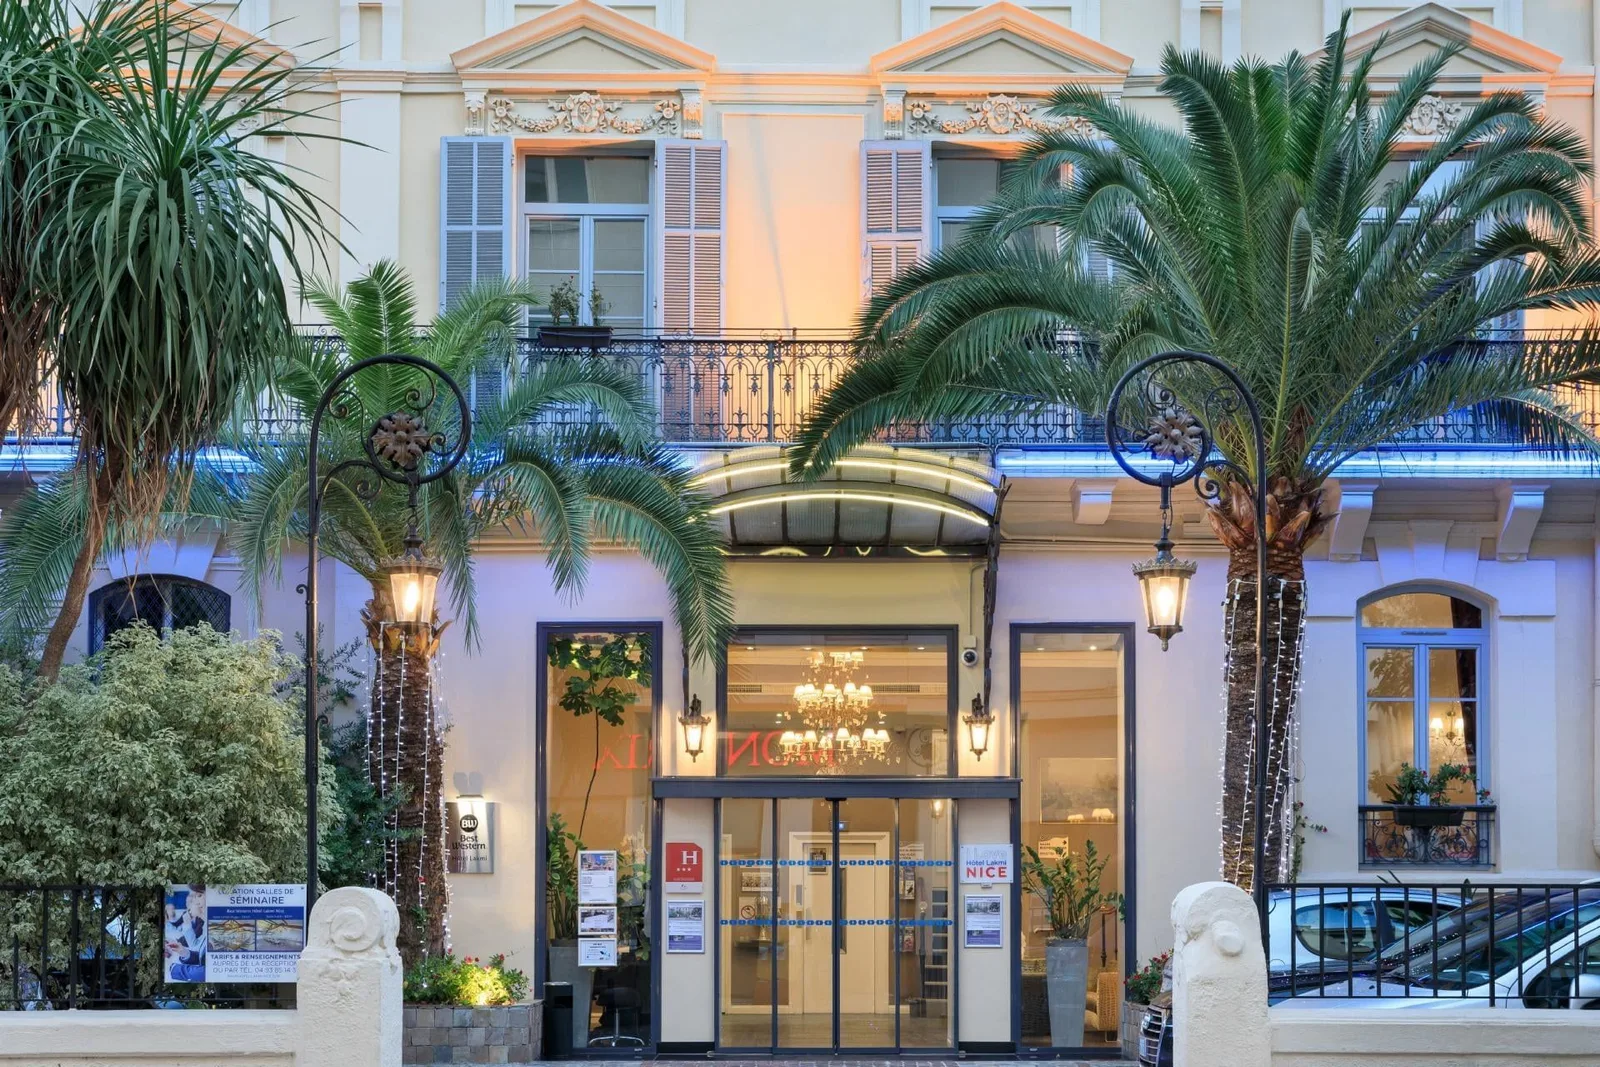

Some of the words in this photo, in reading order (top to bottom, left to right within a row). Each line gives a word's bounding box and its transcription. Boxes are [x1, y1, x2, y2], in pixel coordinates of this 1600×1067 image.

[461, 820, 477, 828] BW
[452, 842, 486, 850] Western
[681, 851, 698, 865] H
[966, 866, 1008, 878] NICE
[230, 895, 284, 905] SÉMINAIRE
